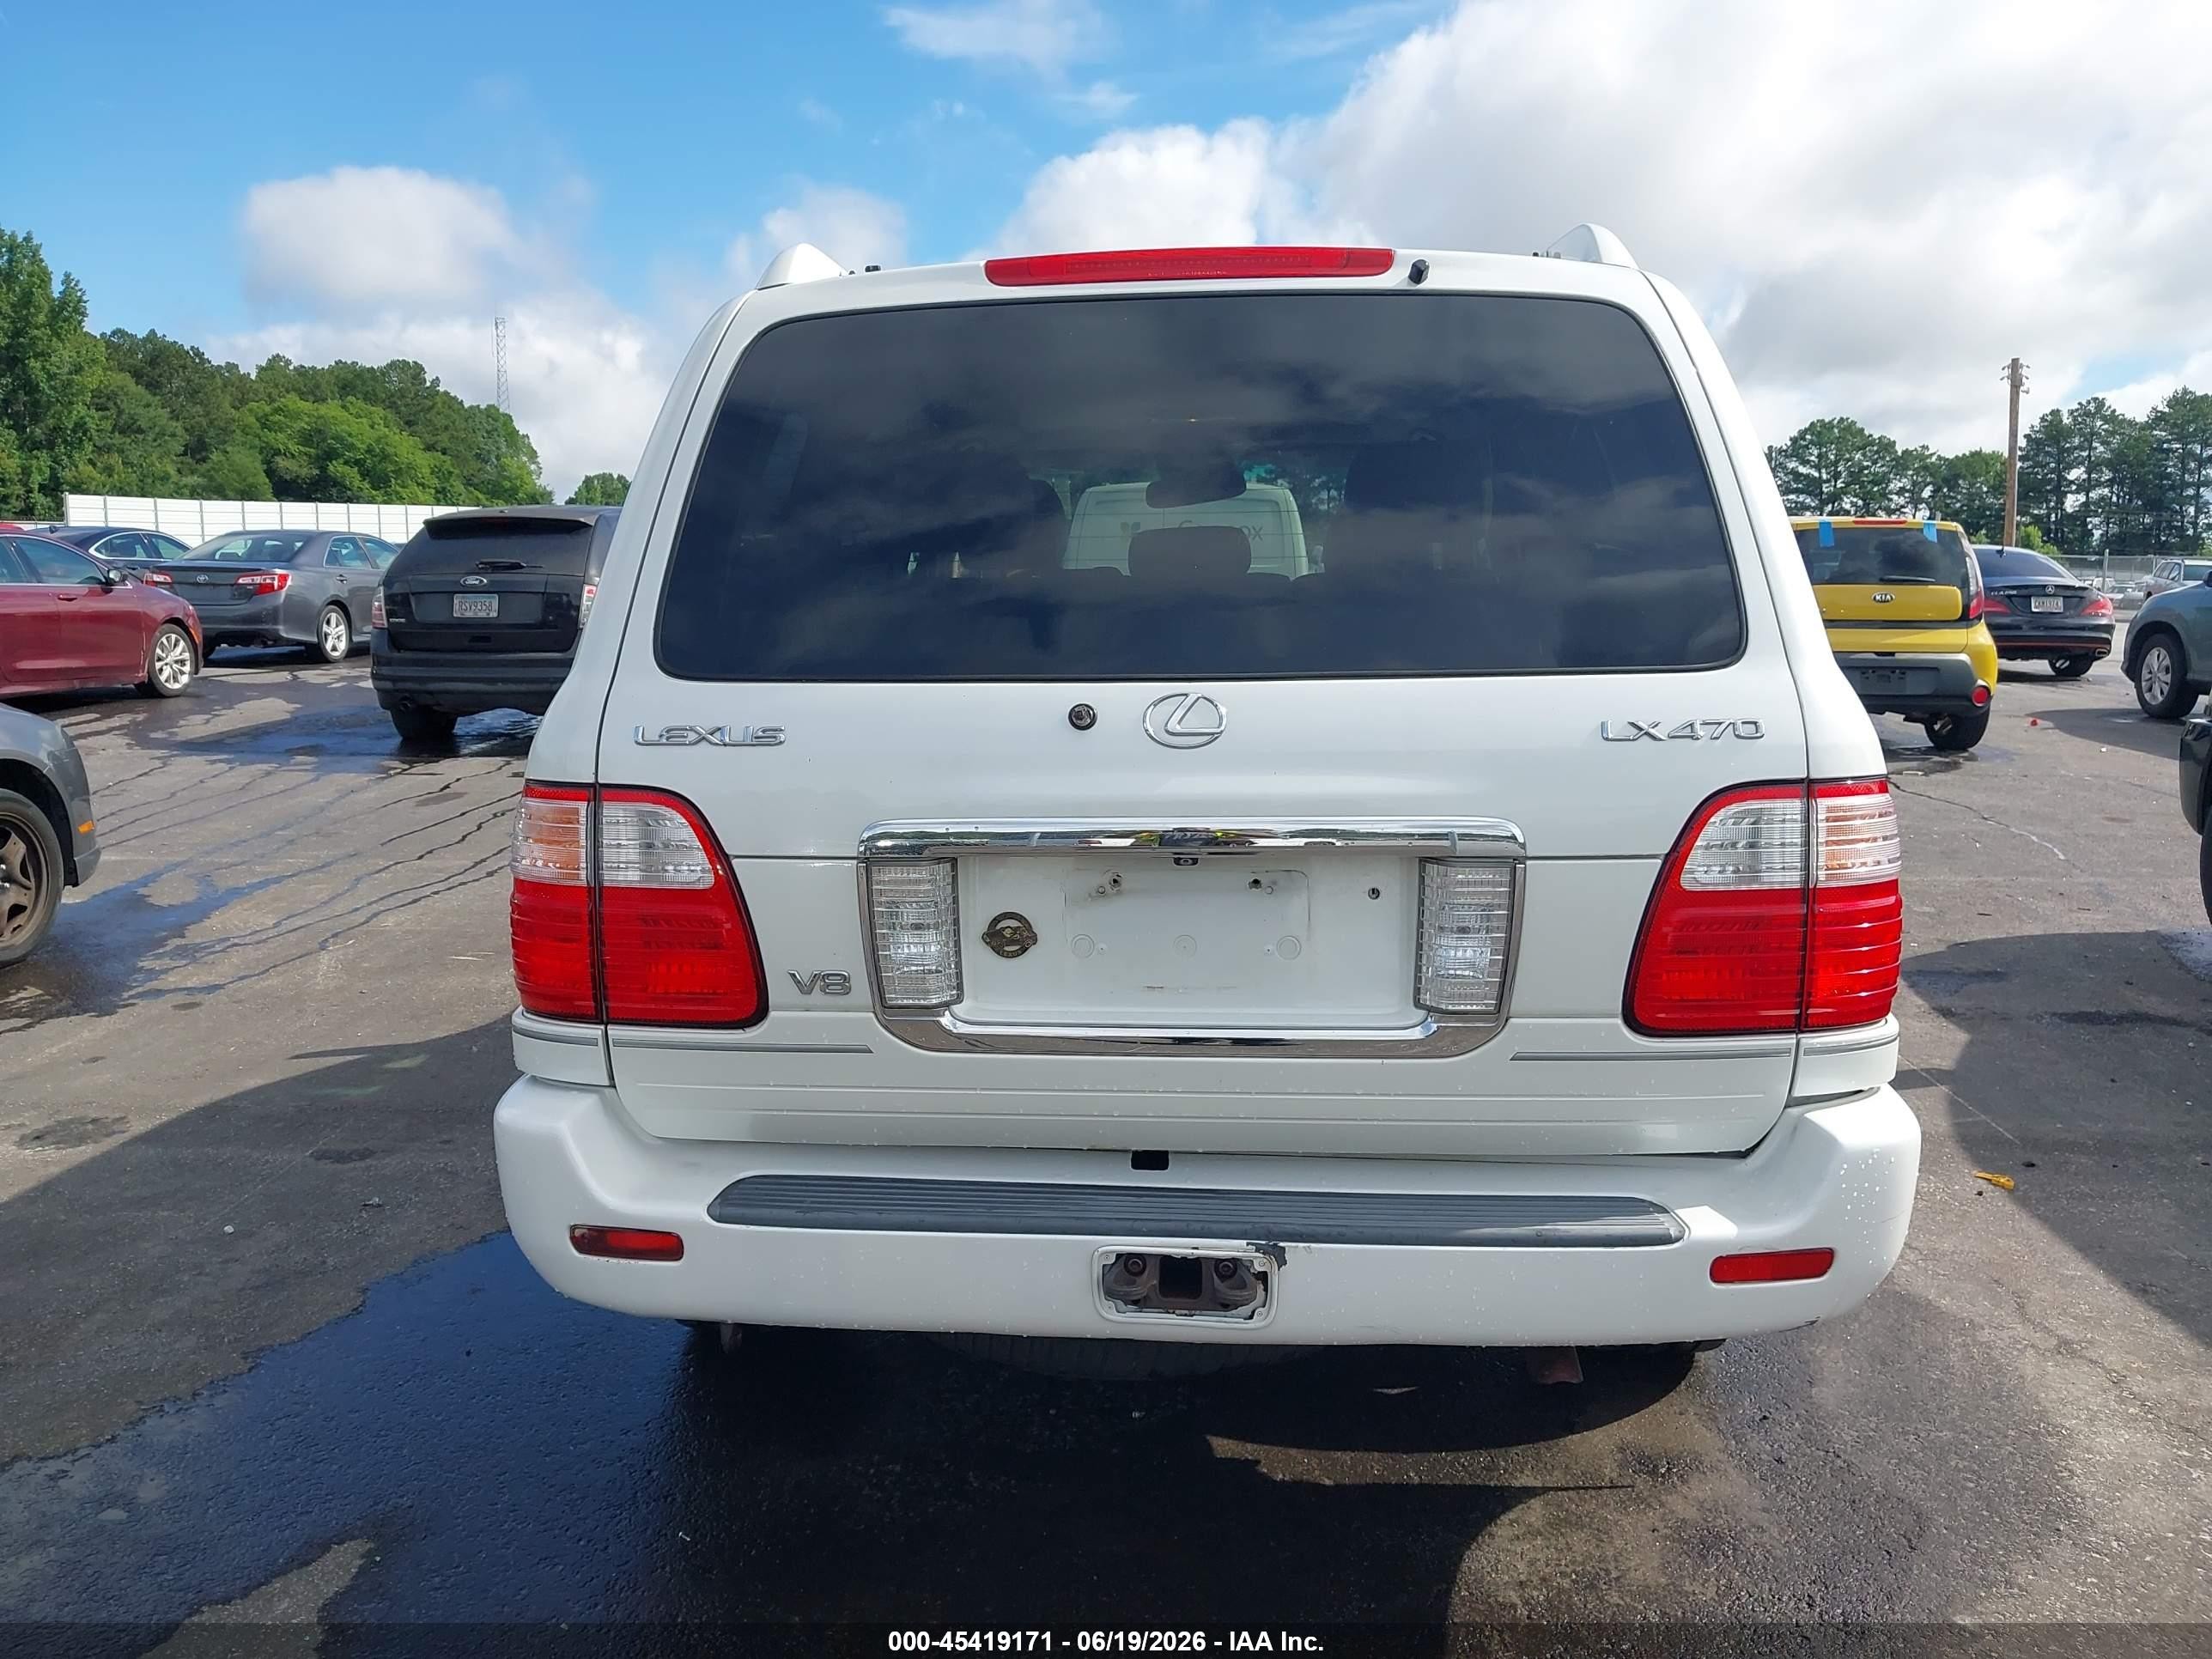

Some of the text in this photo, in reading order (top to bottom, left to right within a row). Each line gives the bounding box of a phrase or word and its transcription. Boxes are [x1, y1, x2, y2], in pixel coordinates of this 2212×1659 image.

[1875, 593, 1892, 602] KIA
[634, 725, 786, 746] LEXUS
[787, 970, 851, 995] V8
